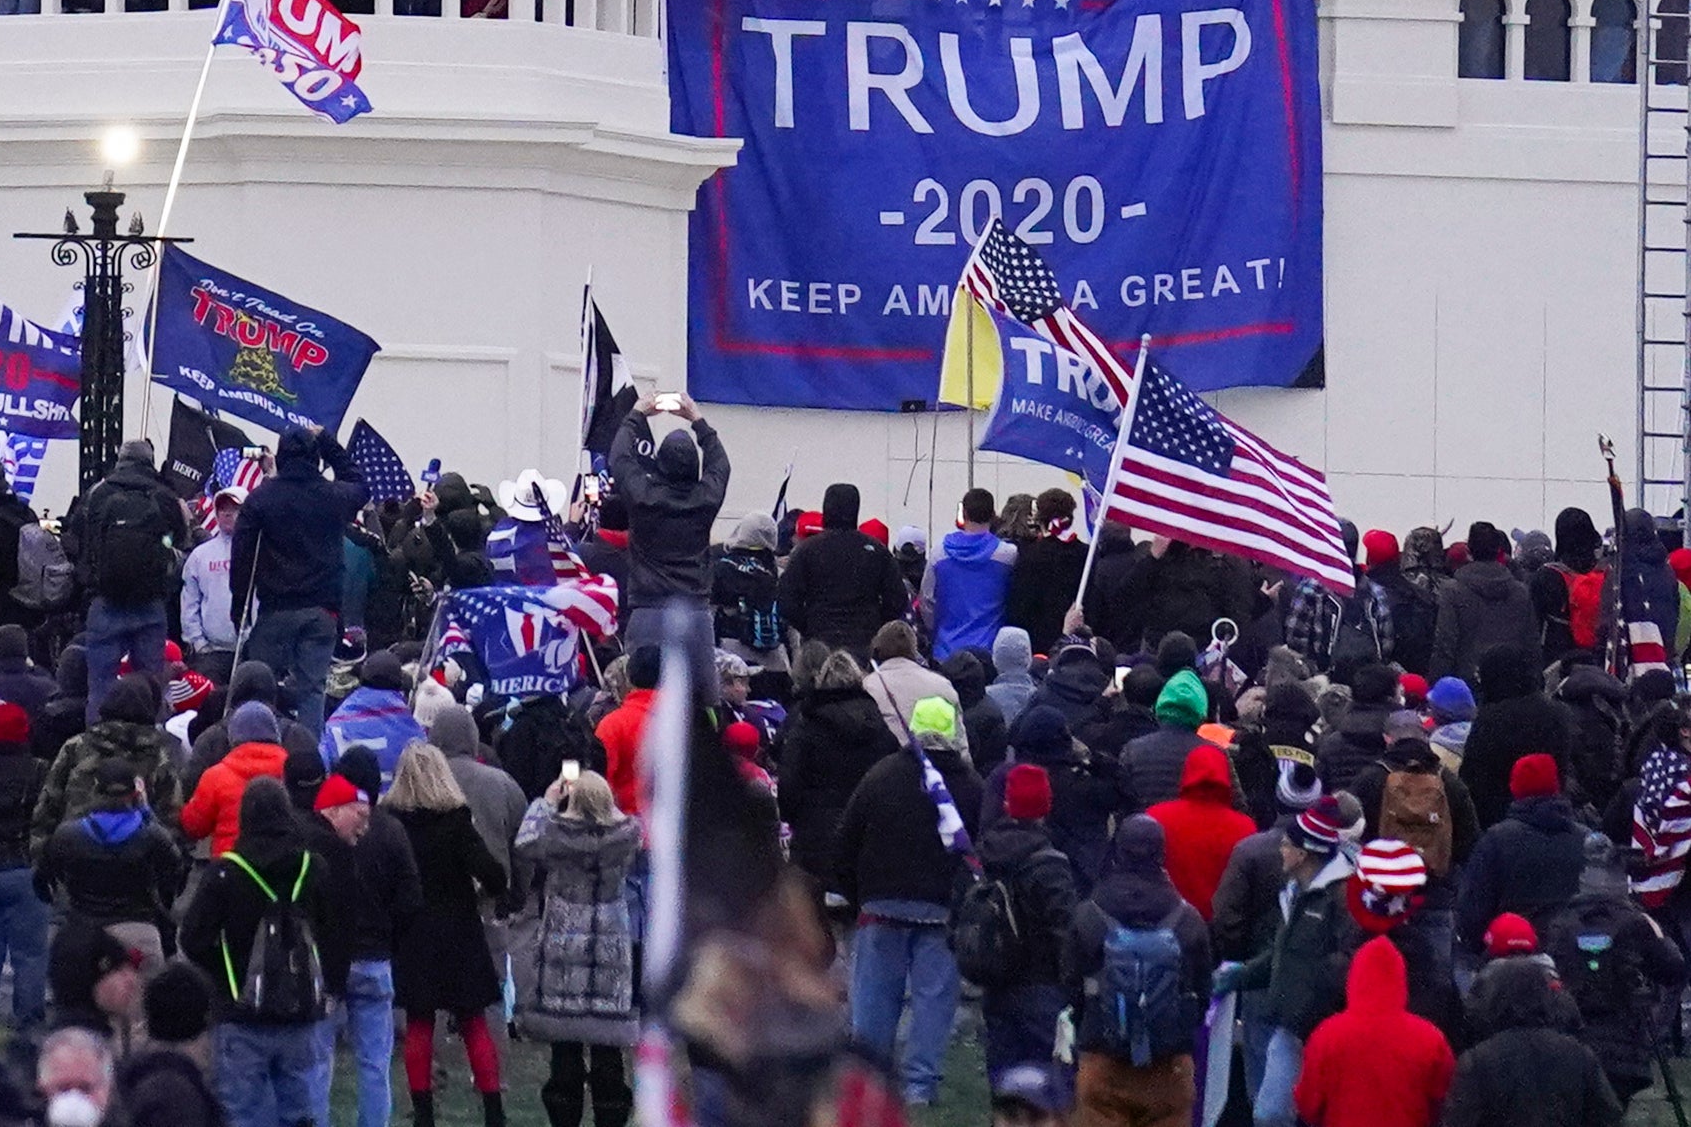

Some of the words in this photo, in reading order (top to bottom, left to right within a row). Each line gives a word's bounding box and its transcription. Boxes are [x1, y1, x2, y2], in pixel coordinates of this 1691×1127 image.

[742, 7, 1253, 137] TRUMP
[200, 279, 245, 301] Don't
[246, 297, 297, 324] Tread
[296, 321, 326, 339] On
[748, 278, 861, 316] KEEP
[1120, 257, 1286, 307] GREAT!
[191, 286, 328, 372] TRUMP
[179, 366, 215, 391] KEEP
[218, 389, 285, 420] AMERICA
[1010, 337, 1120, 415] TRU
[1012, 398, 1053, 421] MAKE
[1085, 424, 1116, 455] GREA
